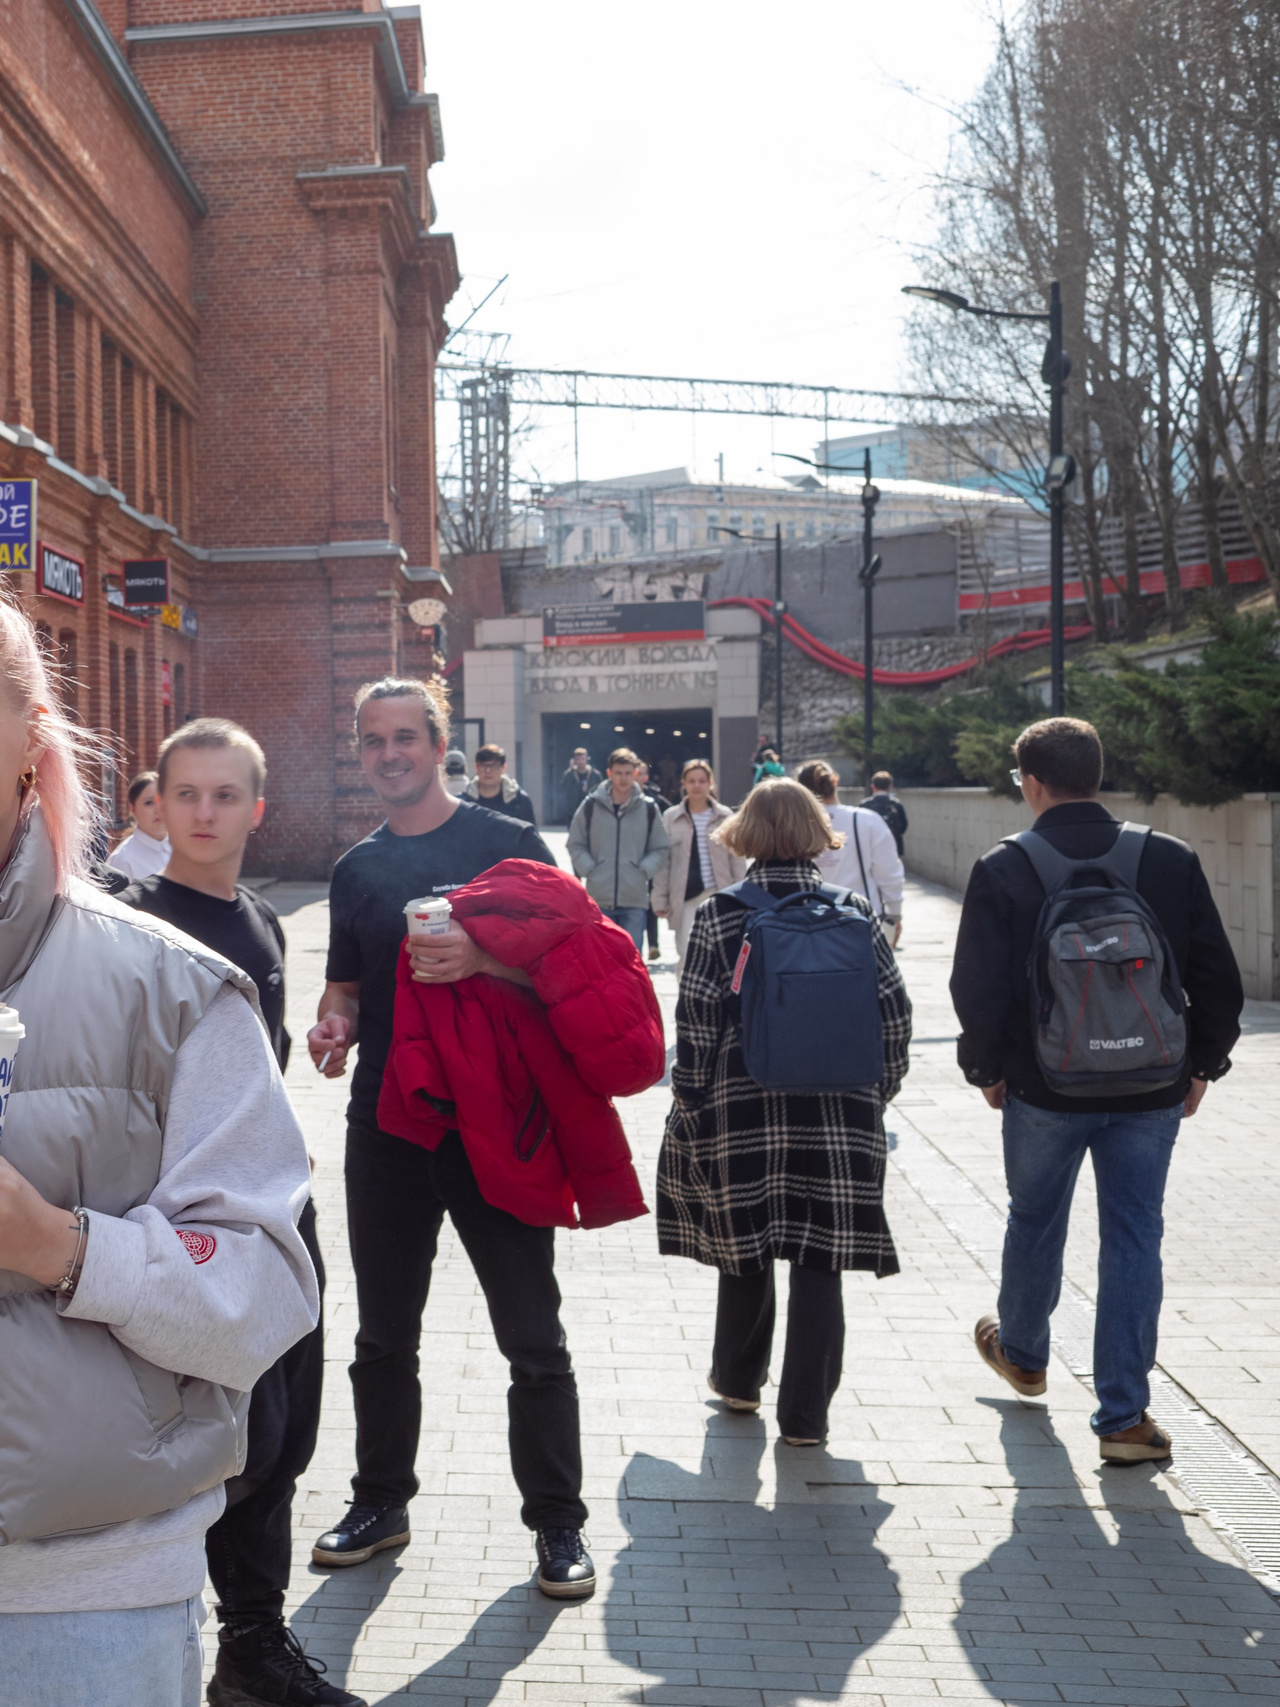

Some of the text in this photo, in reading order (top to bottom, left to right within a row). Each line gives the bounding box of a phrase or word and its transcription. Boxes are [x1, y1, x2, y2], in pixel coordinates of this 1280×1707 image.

[43, 550, 83, 600] МЯКОТЬ
[639, 645, 719, 665] ВОКЗАЛ
[530, 676, 583, 694] ВХОД
[588, 676, 598, 692] В
[607, 672, 688, 692] ТОННЕЛЬ
[1100, 1036, 1145, 1050] VALTEC
